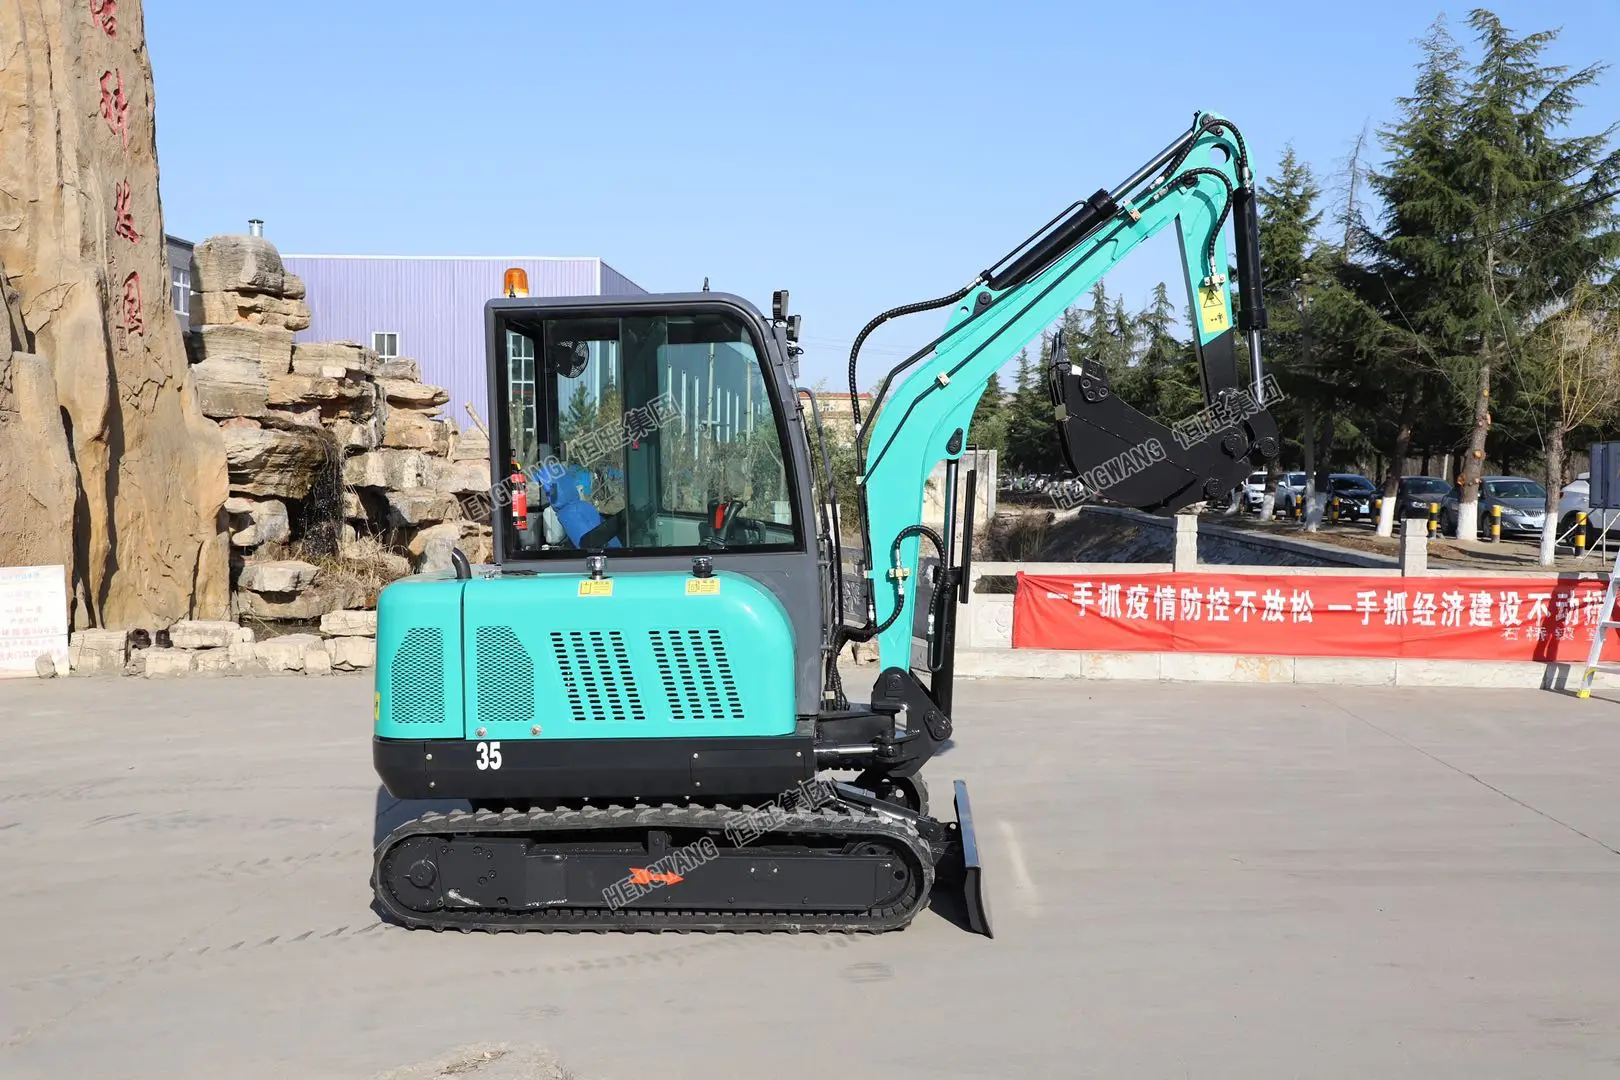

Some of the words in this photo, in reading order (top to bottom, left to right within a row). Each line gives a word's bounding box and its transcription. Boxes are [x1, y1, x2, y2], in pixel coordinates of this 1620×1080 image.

[1047, 582, 1314, 623] 一手抓疫情防控不放松
[476, 741, 502, 770] 35
